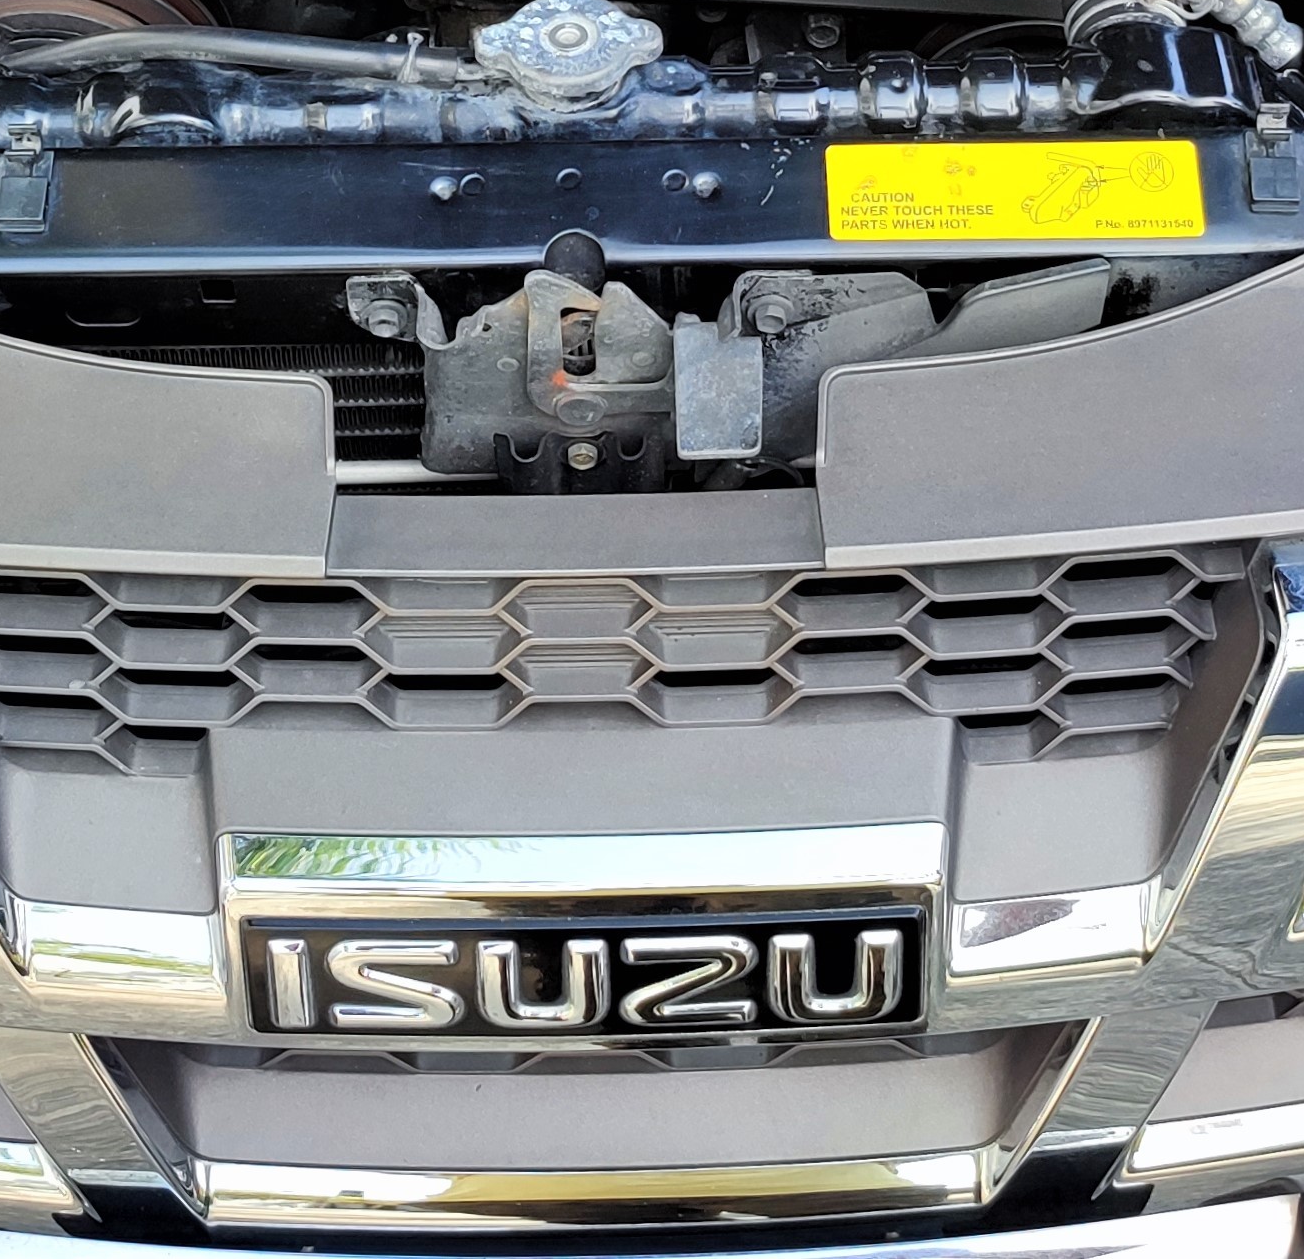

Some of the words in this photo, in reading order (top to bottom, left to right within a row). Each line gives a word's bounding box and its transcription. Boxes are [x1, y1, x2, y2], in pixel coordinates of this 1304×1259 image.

[851, 192, 915, 203] CAUTION
[841, 205, 888, 216] NEVER
[894, 204, 944, 216] TOUCH
[948, 204, 994, 215] THESE
[841, 219, 888, 230] PARTS
[892, 218, 936, 230] WHEN
[939, 218, 972, 230] HOT.
[267, 928, 904, 1029] ISUZU
